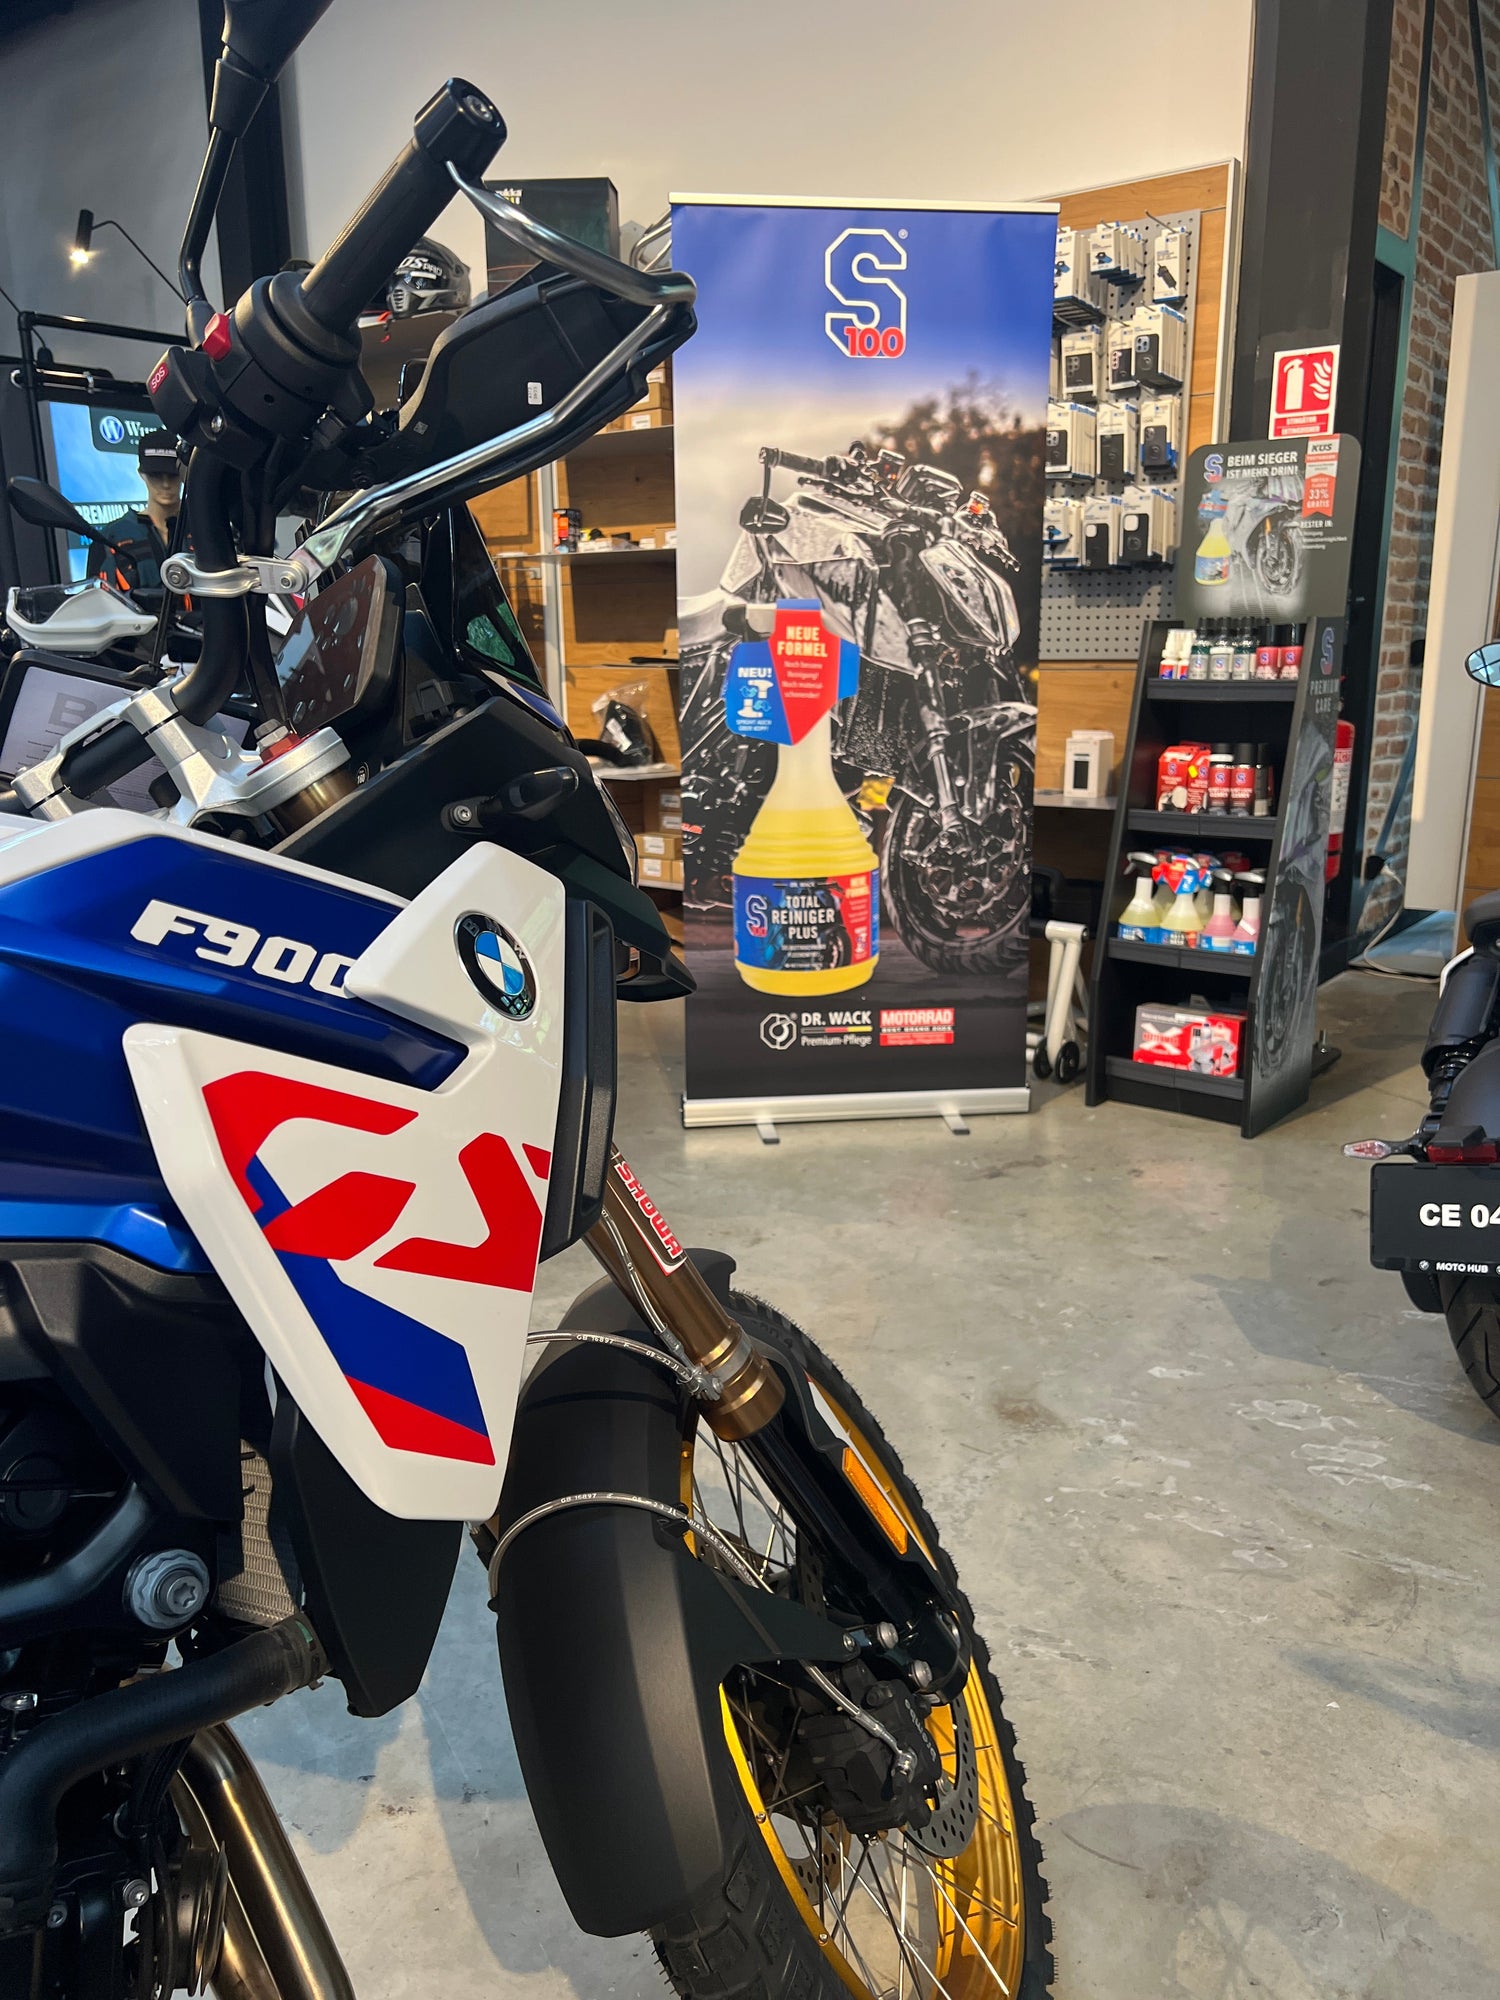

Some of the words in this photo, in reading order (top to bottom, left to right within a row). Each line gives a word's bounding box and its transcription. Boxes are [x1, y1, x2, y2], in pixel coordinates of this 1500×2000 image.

[844, 326, 906, 358] 100
[151, 366, 166, 389] SOS
[1227, 453, 1256, 468] BEIM
[1258, 451, 1298, 465] SIEGER
[1226, 467, 1240, 479] IST
[1241, 466, 1268, 479] MEHR
[1271, 465, 1299, 477] DRIN!
[1308, 488, 1329, 500] 33%
[786, 625, 821, 641] NEUE
[777, 640, 828, 658] FORMEL
[737, 667, 773, 678] NEU!
[785, 895, 821, 909] TOTAL
[771, 909, 836, 925] REINIGER
[788, 926, 819, 940] PLUS
[801, 1012, 826, 1026] DR.
[828, 1010, 872, 1025] WACK
[881, 1009, 952, 1026] MOTORRAD
[801, 1035, 873, 1047] Premium-Pflege
[614, 1161, 684, 1260] SHOWA
[1419, 1203, 1461, 1227] CE
[1436, 1262, 1467, 1272] MOTO
[1467, 1264, 1489, 1274] HUB
[560, 1496, 572, 1504] GB
